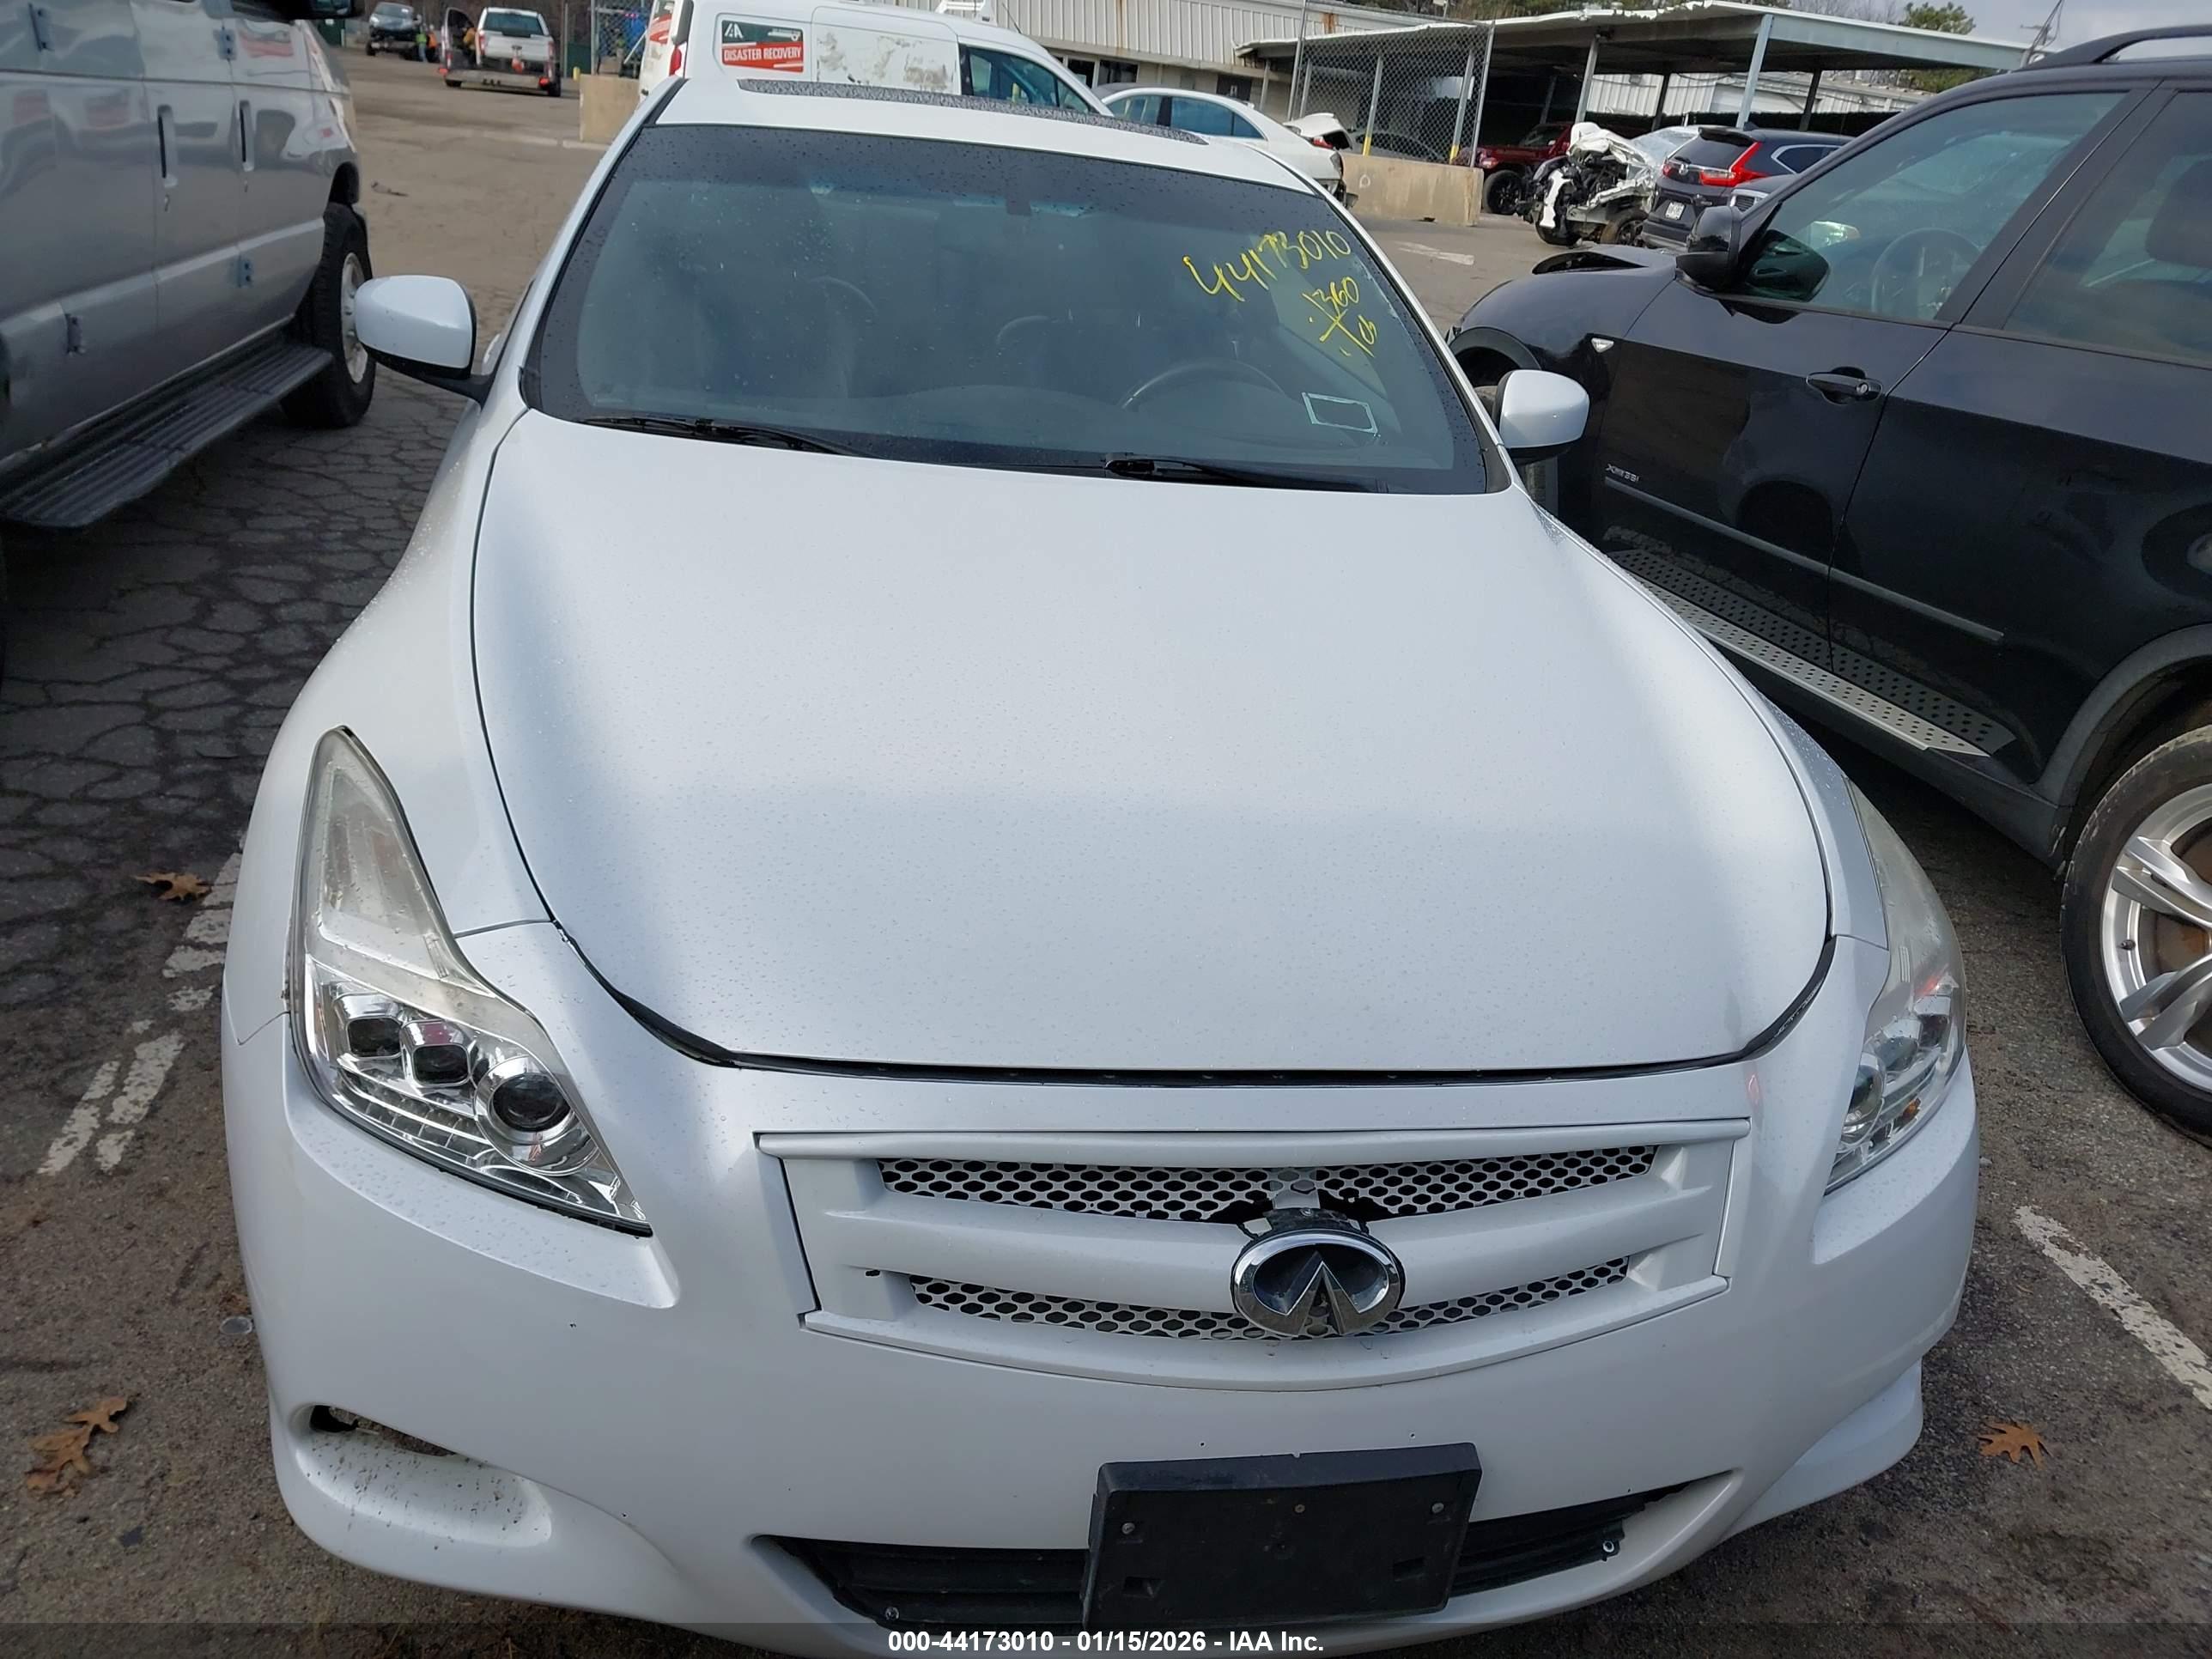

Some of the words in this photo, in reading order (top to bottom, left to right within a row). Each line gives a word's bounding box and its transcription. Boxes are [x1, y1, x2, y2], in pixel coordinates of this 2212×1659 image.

[724, 48, 762, 61] DISASTER
[763, 46, 801, 59] RECOVERY
[1182, 229, 1352, 301] 44173010
